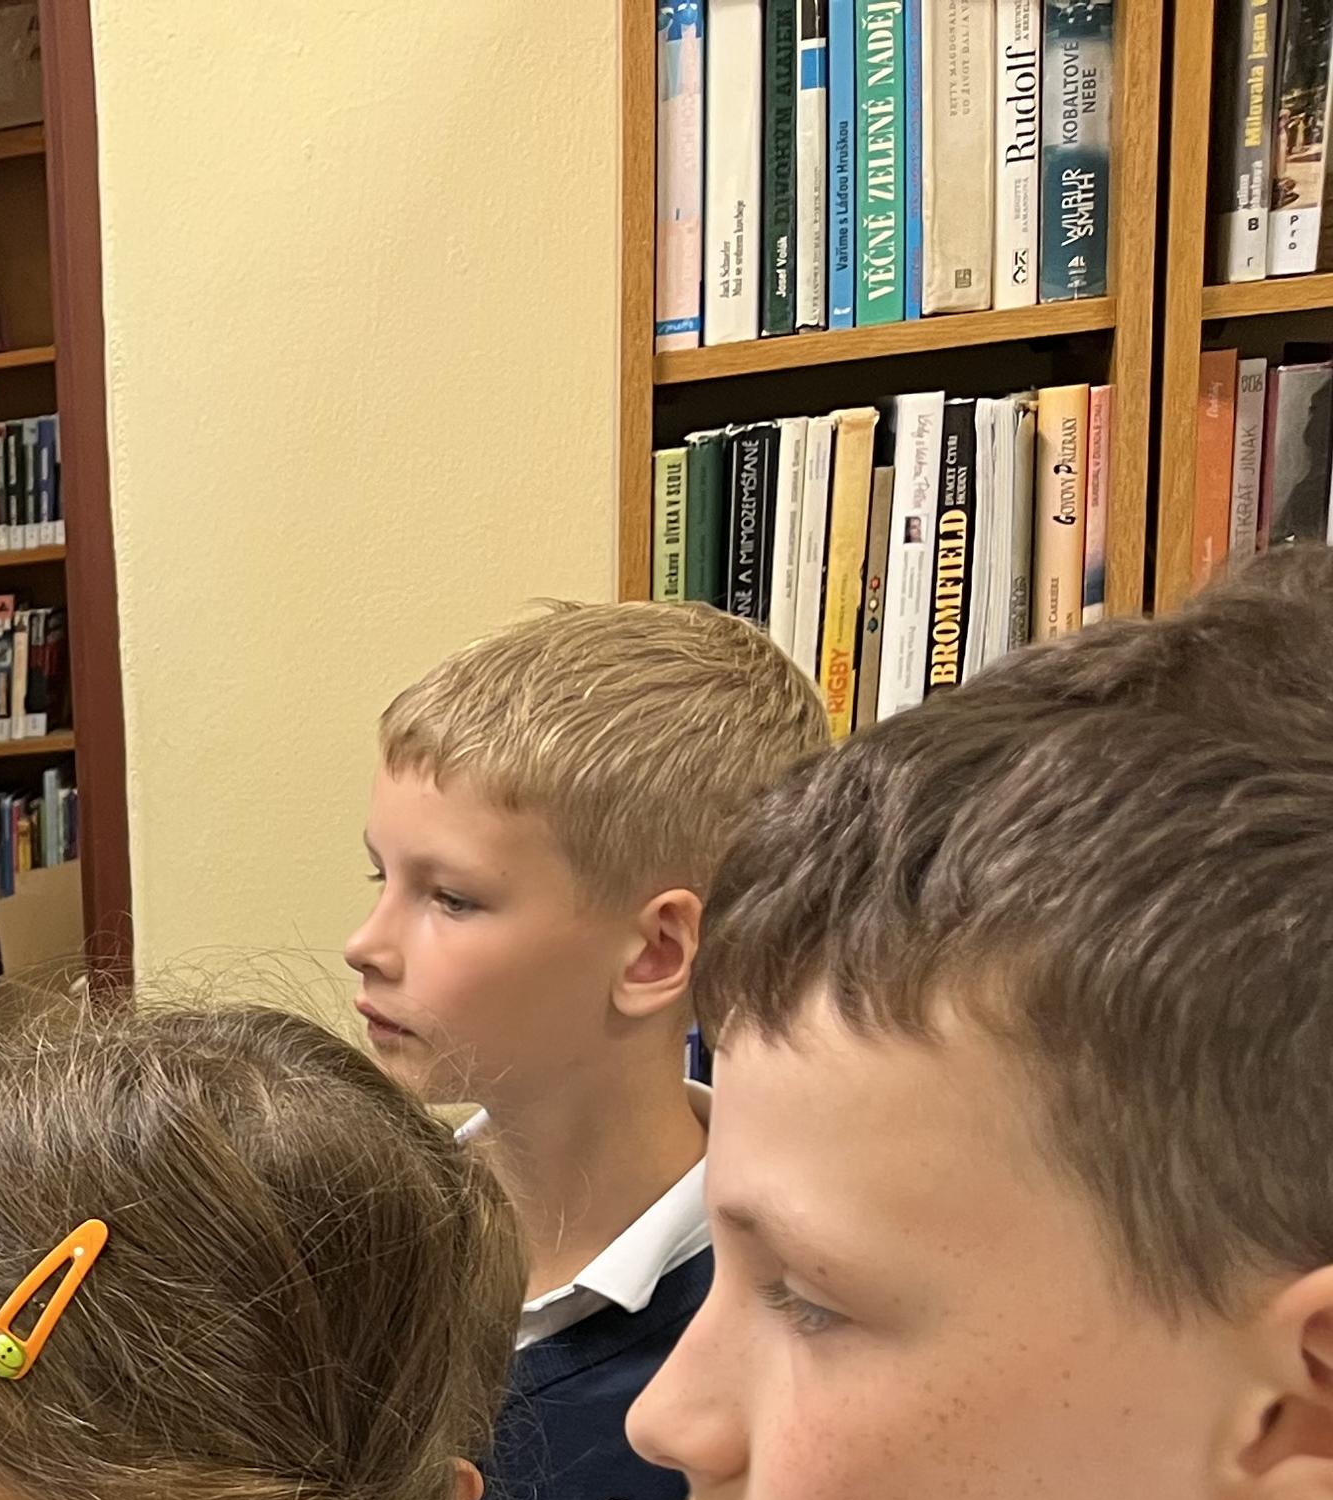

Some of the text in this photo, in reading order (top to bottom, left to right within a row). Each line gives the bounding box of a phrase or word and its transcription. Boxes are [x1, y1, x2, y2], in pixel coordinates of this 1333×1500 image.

[1005, 46, 1037, 168] Rudolf
[1062, 40, 1081, 146] KOBALTOVÉ
[1082, 67, 1097, 114] NEBE
[861, 97, 896, 203] ZELENÉ
[834, 120, 849, 272] Vaříme s Láďou Hruškou
[1061, 167, 1083, 248] WILBUR
[1077, 172, 1096, 237] SMITH
[775, 268, 788, 298] Josef
[863, 209, 896, 302] VĚČNĚ
[667, 462, 683, 495] SEDLE
[1243, 422, 1259, 477] JINAK
[666, 507, 681, 545] DÍVKA
[667, 499, 681, 507] V
[931, 509, 968, 687] BROMFIELD
[827, 647, 850, 715] RIGBY
